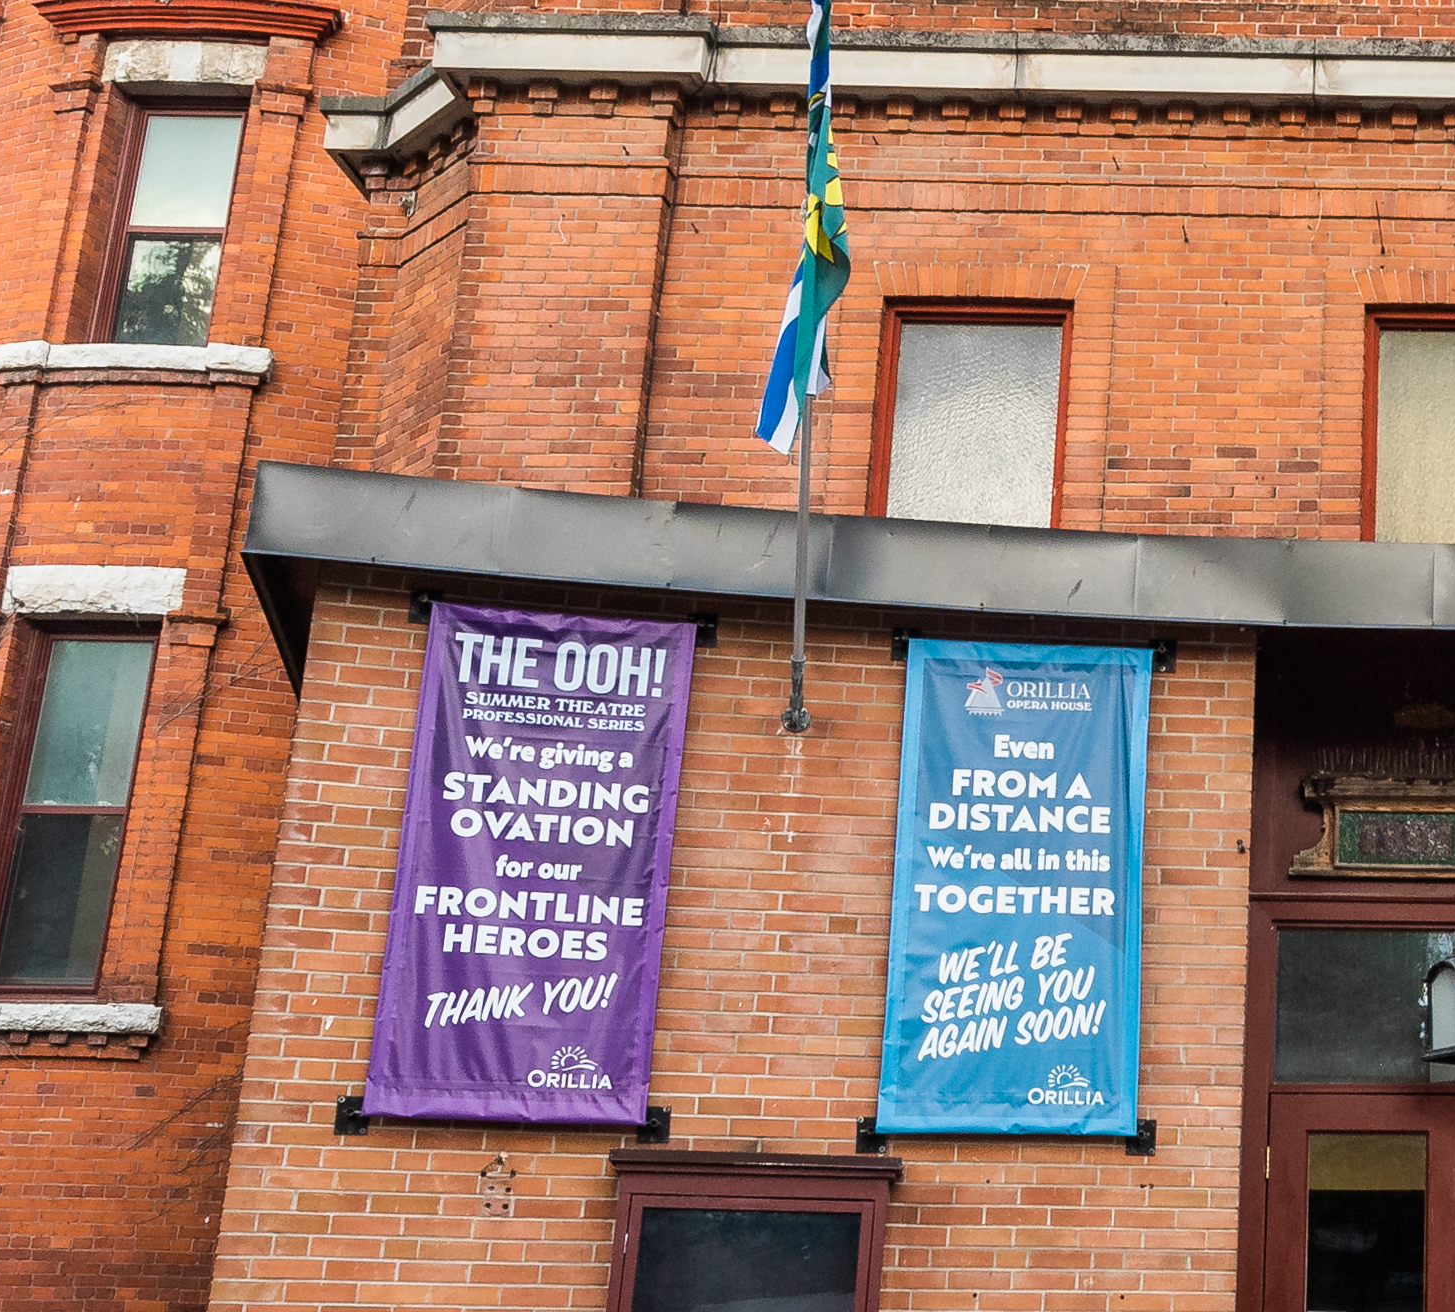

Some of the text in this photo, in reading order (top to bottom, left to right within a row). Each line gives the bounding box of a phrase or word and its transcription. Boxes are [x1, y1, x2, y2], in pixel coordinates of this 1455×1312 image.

[455, 632, 666, 698] THE OOH!
[464, 691, 646, 717] SUMMER THEATRE
[1006, 681, 1091, 700] ORILLIA
[1006, 699, 1092, 711] OPERA HOUSE
[462, 708, 645, 732] PROFESSIONAL SERIES
[465, 736, 634, 772] We're giving a
[994, 735, 1054, 759] Even
[443, 772, 649, 814] STANDING
[952, 769, 1091, 799] FROM A
[450, 810, 634, 848] OVATION
[929, 804, 1111, 834] DISTANCE
[495, 855, 581, 881] for our
[928, 845, 1110, 873] We're all in this
[414, 886, 644, 927] FRONTLINE
[914, 884, 1115, 916] TOGETHER
[443, 923, 608, 961] HEROES
[939, 933, 1073, 984] WE'LL BE
[424, 973, 618, 1029] THANK YOU!
[921, 966, 1095, 1024] SEEING YOU
[917, 1000, 1106, 1062] AGAIN SOON!
[1028, 1087, 1104, 1106] ORILLIA
